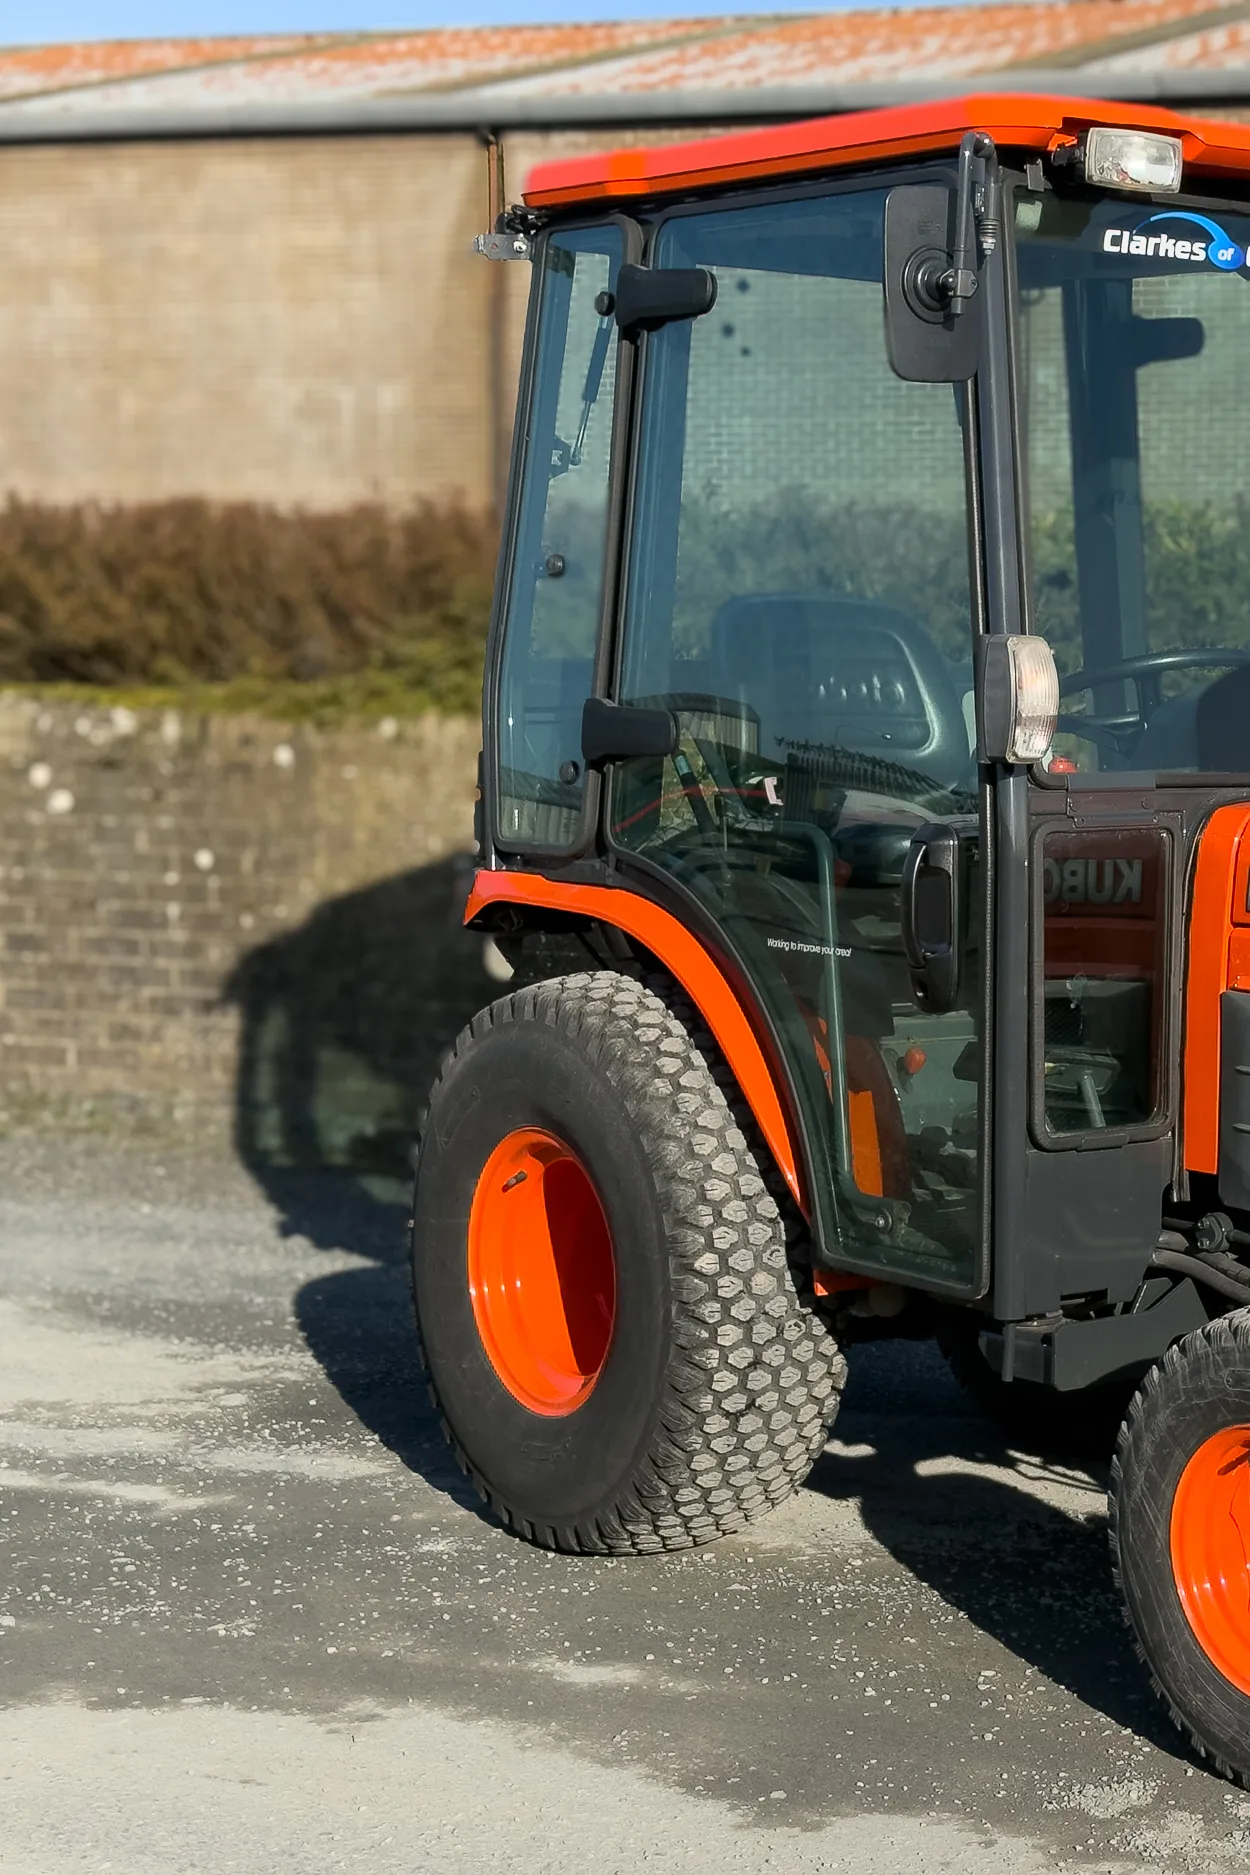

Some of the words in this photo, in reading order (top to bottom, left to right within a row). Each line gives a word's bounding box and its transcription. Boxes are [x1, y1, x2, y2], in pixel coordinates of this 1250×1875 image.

[1103, 229, 1207, 262] Clarkes
[1216, 247, 1236, 262] of
[767, 938, 790, 952] Working
[797, 941, 821, 953] improve
[821, 946, 834, 956] your
